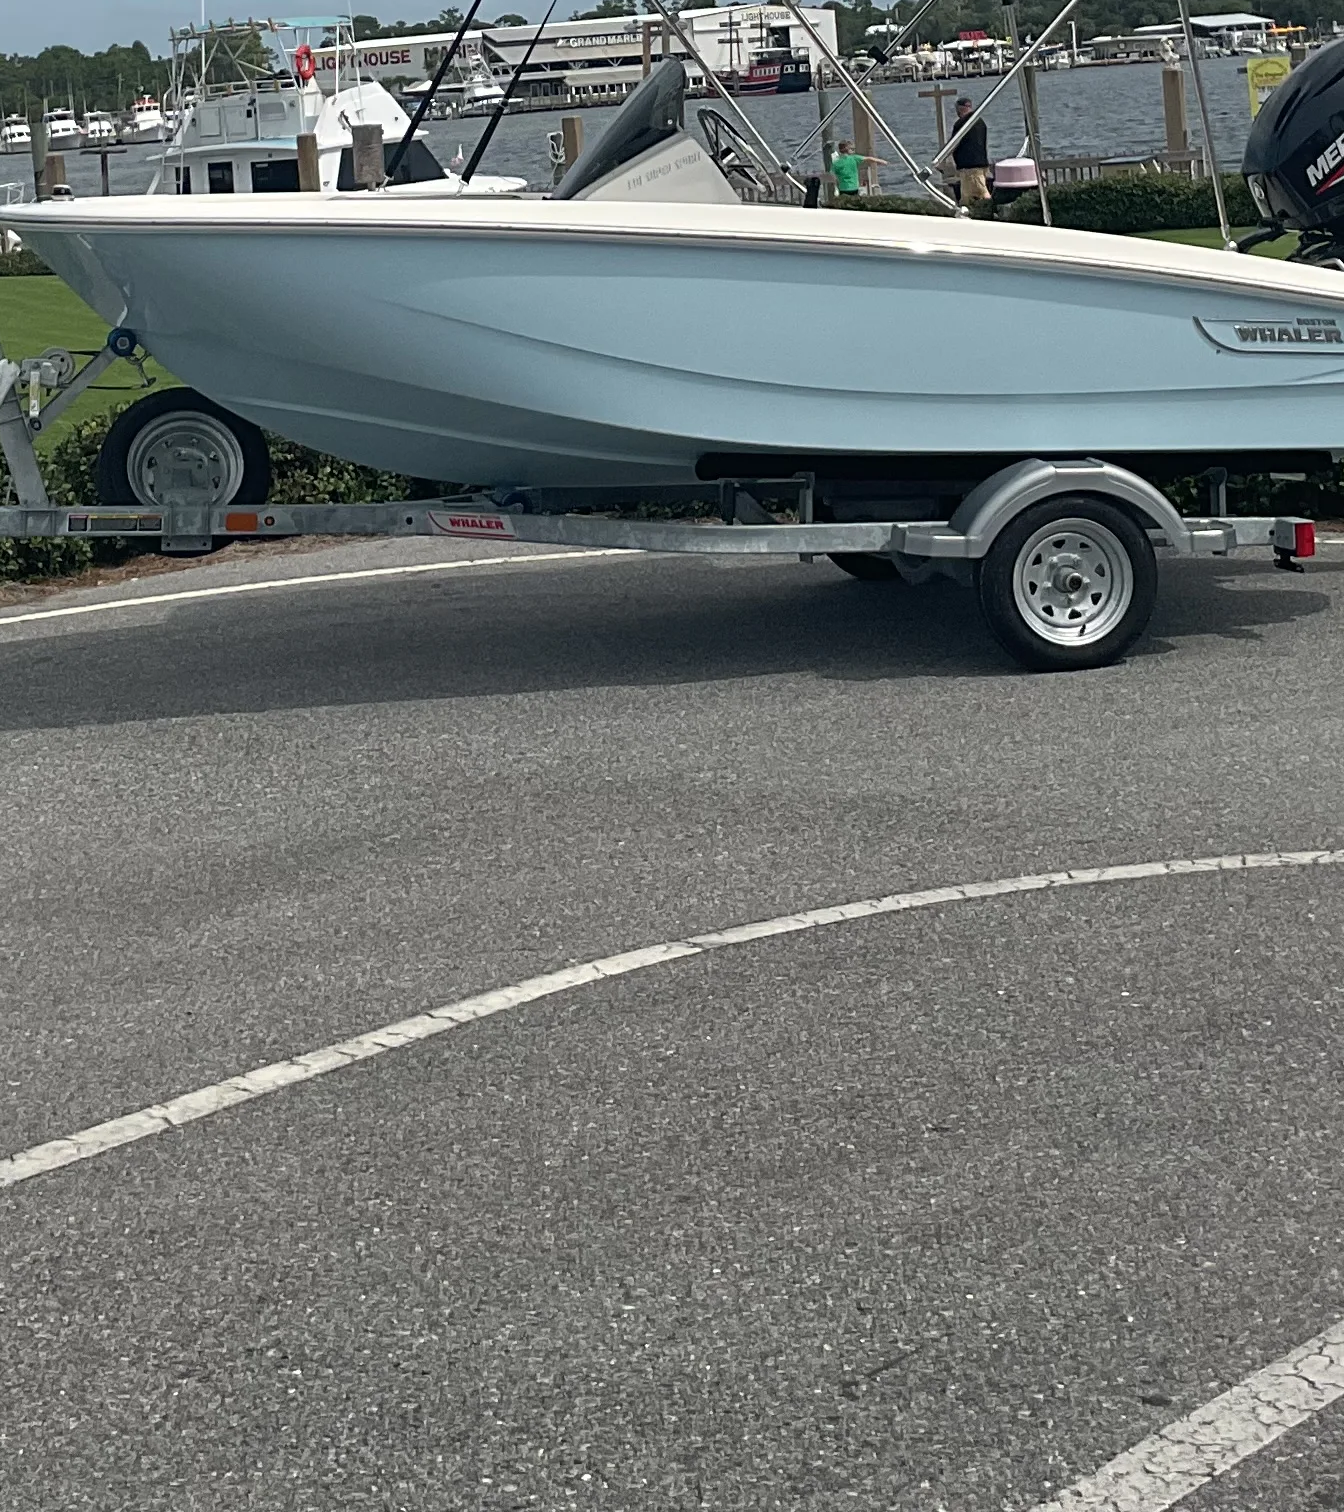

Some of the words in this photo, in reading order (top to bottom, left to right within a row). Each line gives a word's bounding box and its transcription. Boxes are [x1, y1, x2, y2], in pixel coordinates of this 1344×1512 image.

[569, 35, 607, 48] GRAND
[1296, 318, 1336, 326] BOSTON
[1234, 325, 1344, 344] WHALER
[449, 518, 505, 530] WHALER
